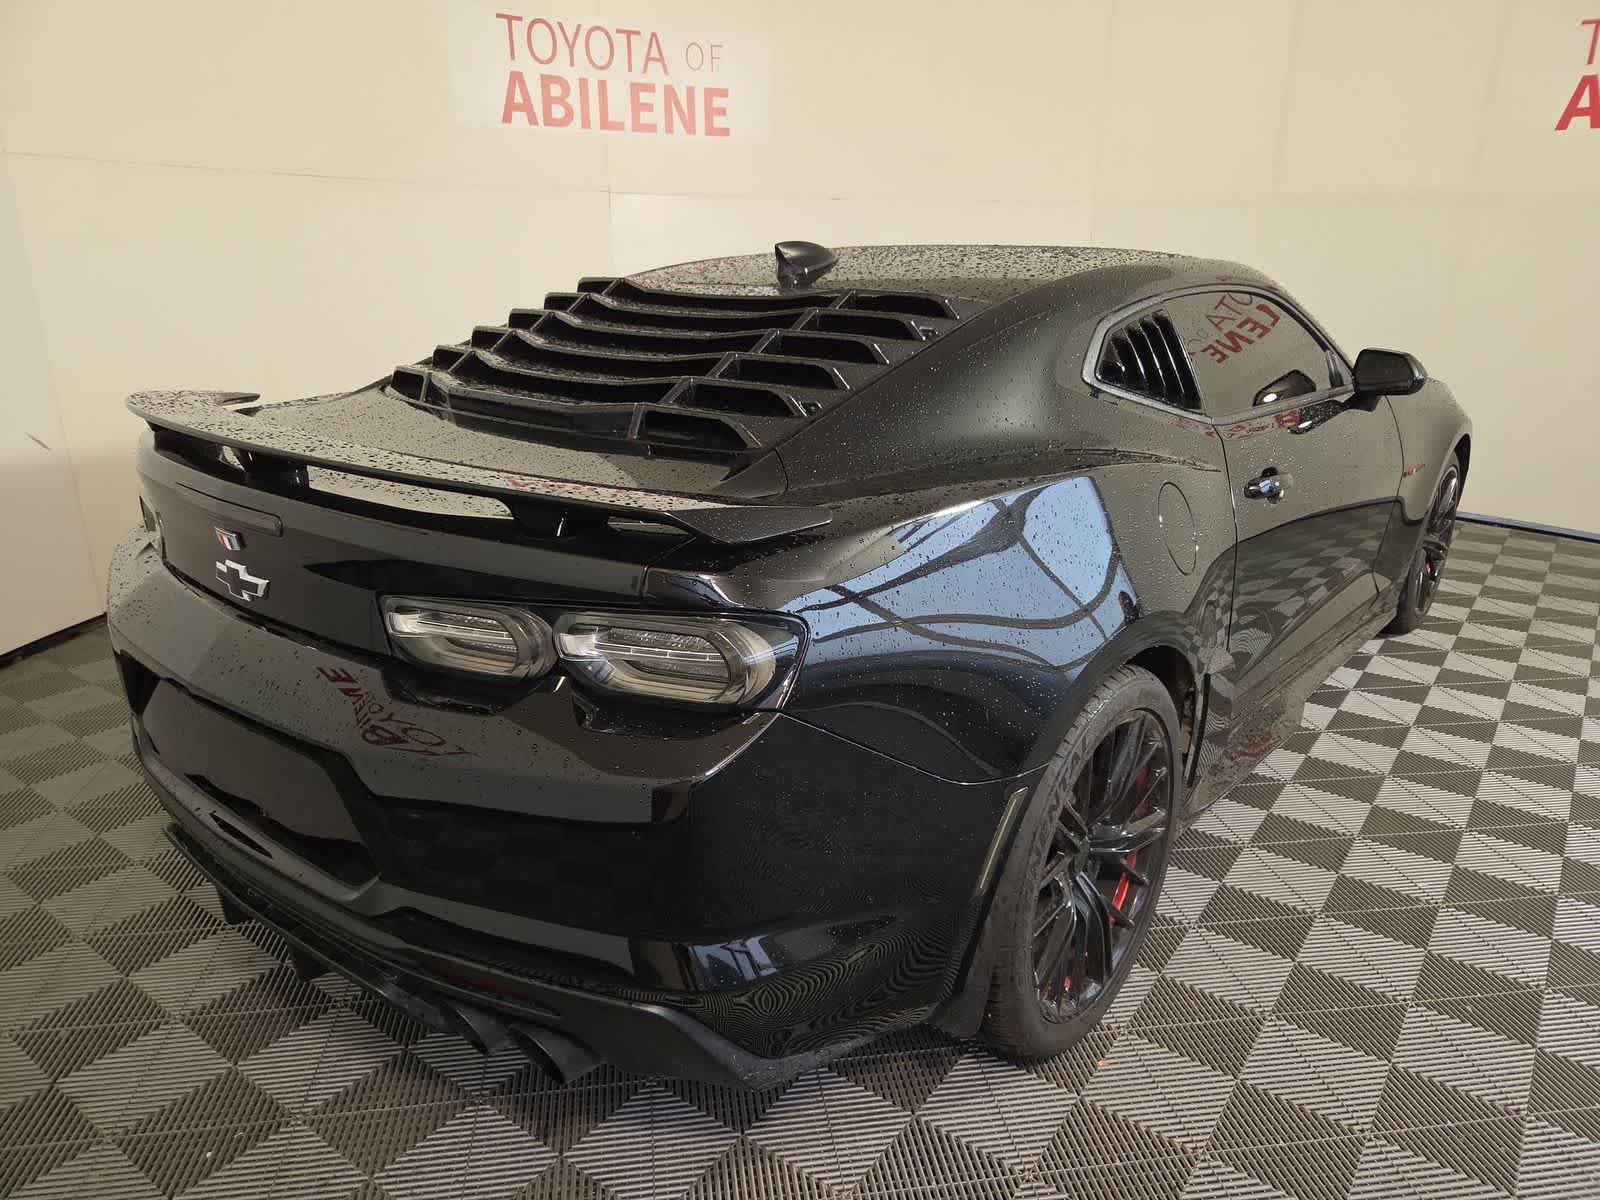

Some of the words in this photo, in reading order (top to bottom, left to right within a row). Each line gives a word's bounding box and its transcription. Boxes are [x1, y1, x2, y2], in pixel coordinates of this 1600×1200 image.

[496, 13, 669, 75] TOYOTA
[685, 42, 723, 72] OF
[501, 70, 730, 137] ABILENE
